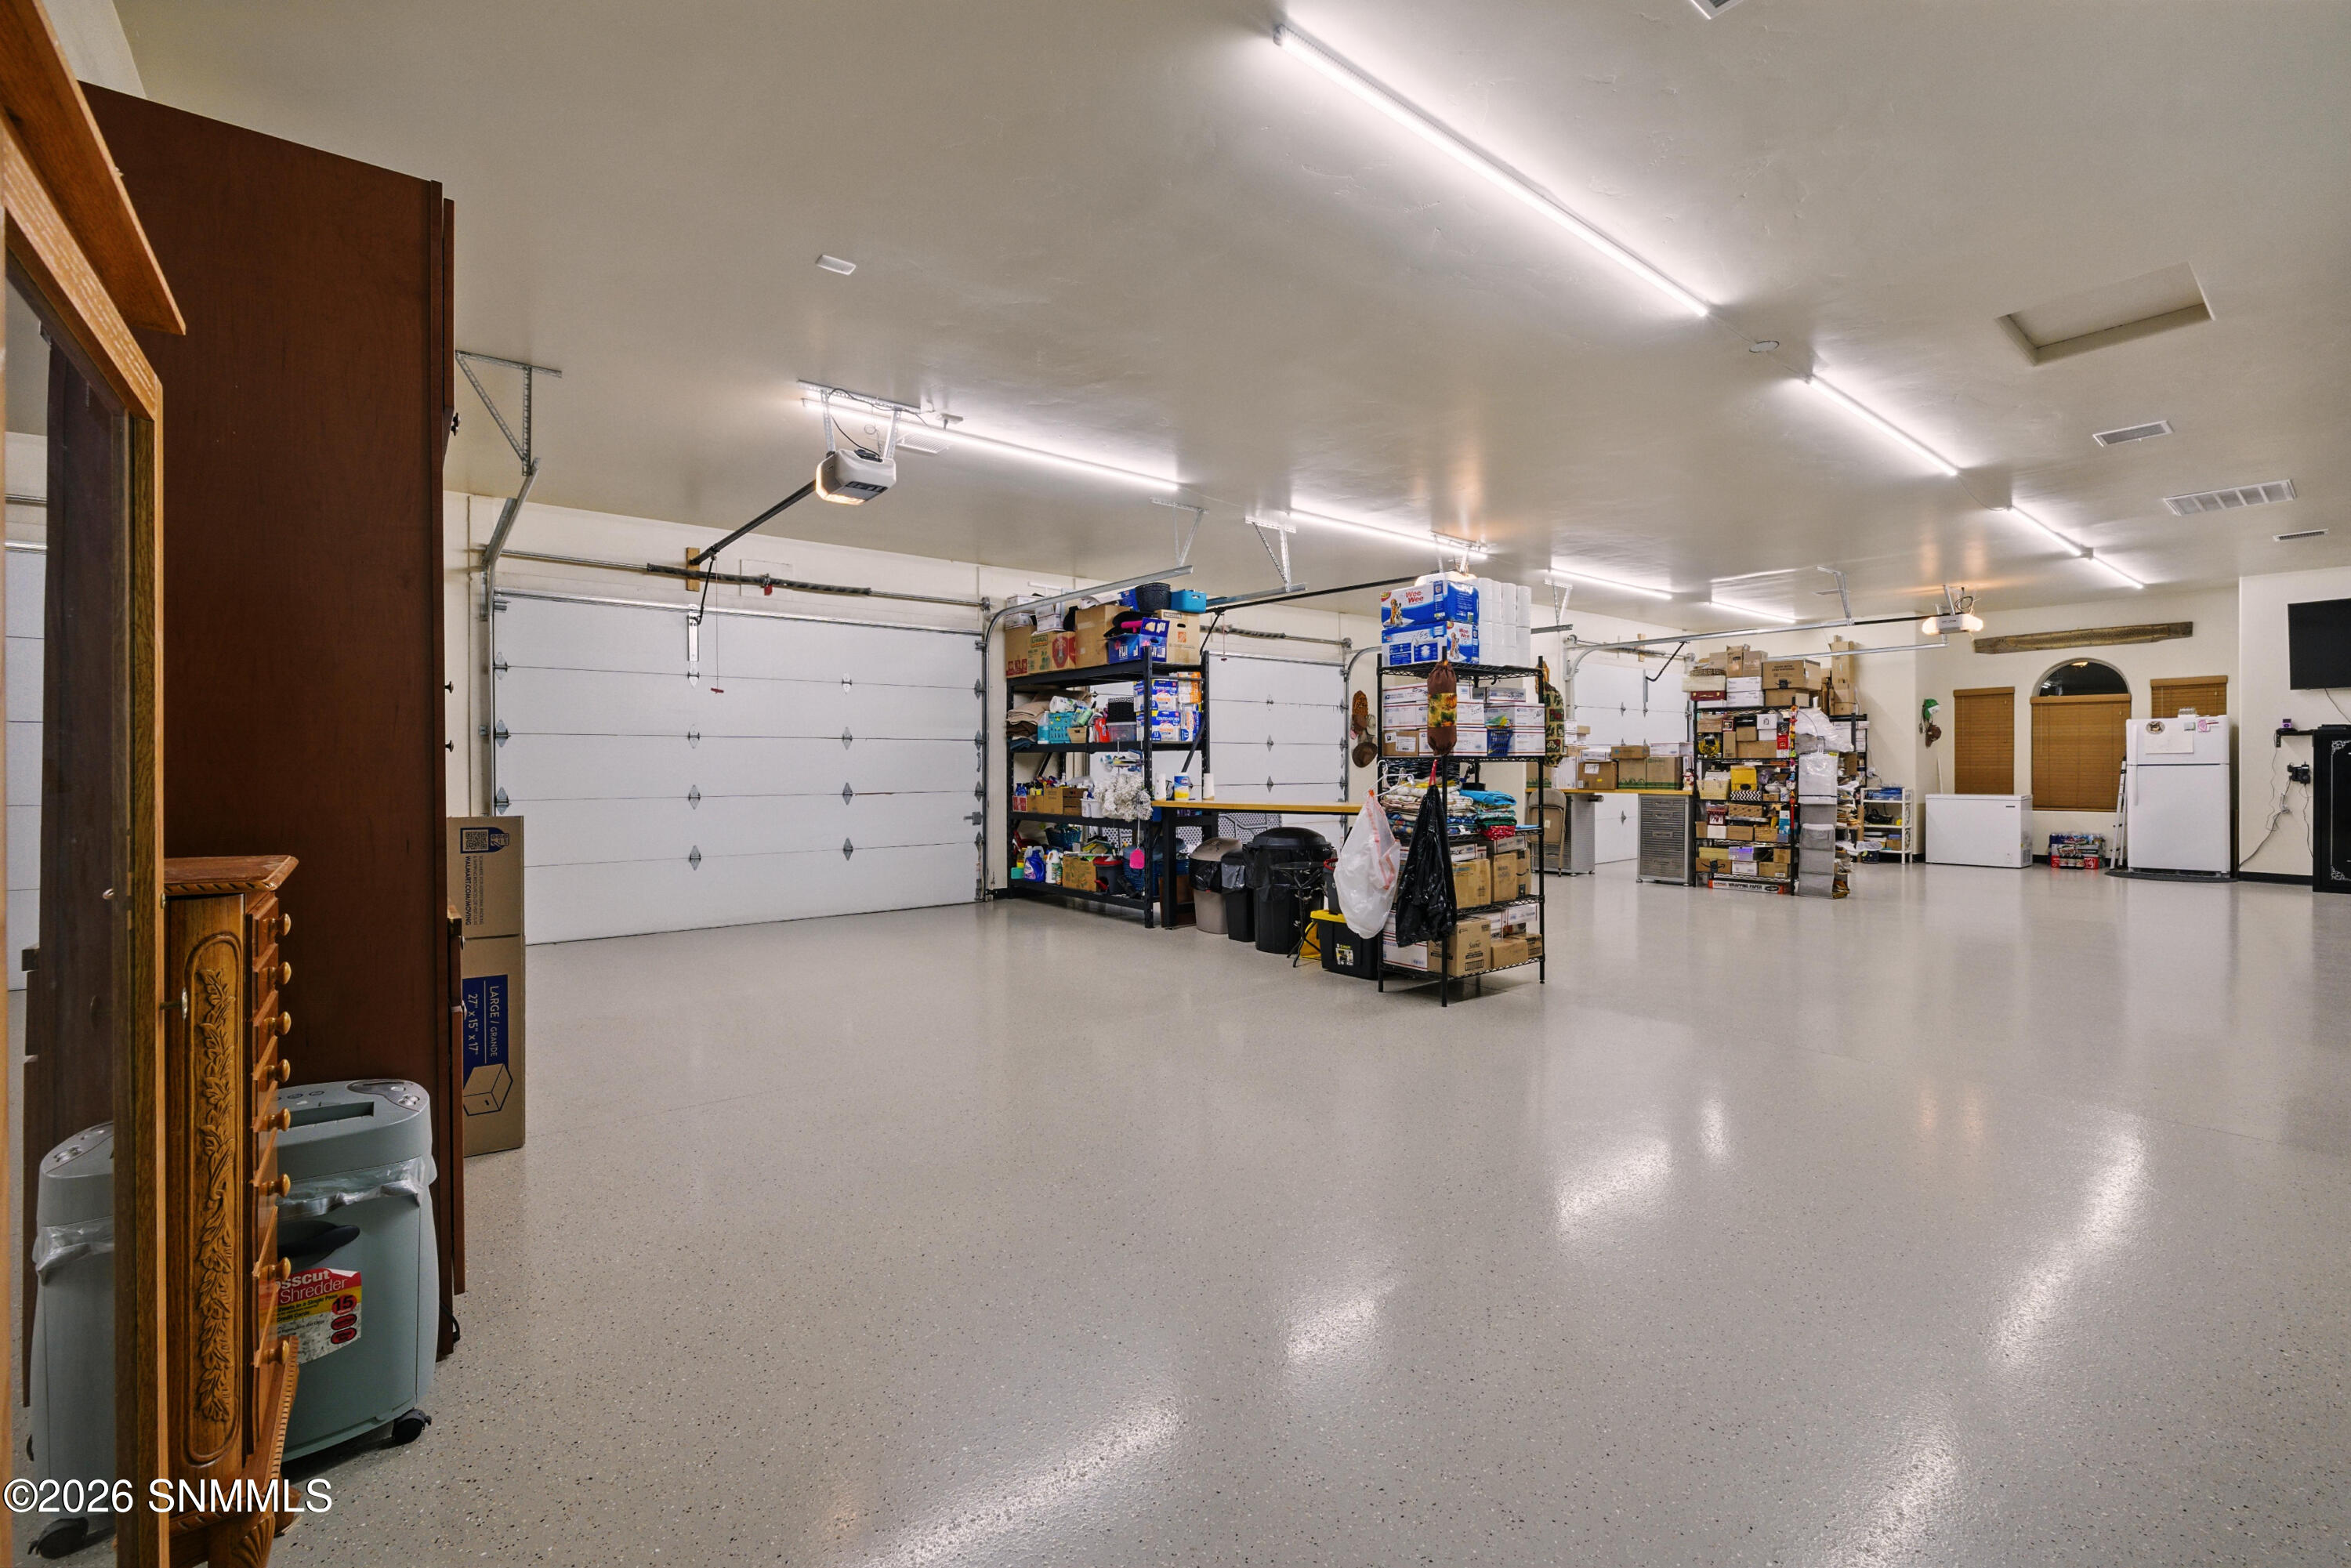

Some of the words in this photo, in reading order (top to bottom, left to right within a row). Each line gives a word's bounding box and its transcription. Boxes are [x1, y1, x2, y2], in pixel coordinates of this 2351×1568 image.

[468, 994, 478, 1009] 27"
[489, 985, 499, 1018] LARGE
[469, 1019, 479, 1031] 15"
[469, 1042, 479, 1055] 17"
[280, 1279, 347, 1304] Shredder
[333, 1295, 354, 1311] 15
